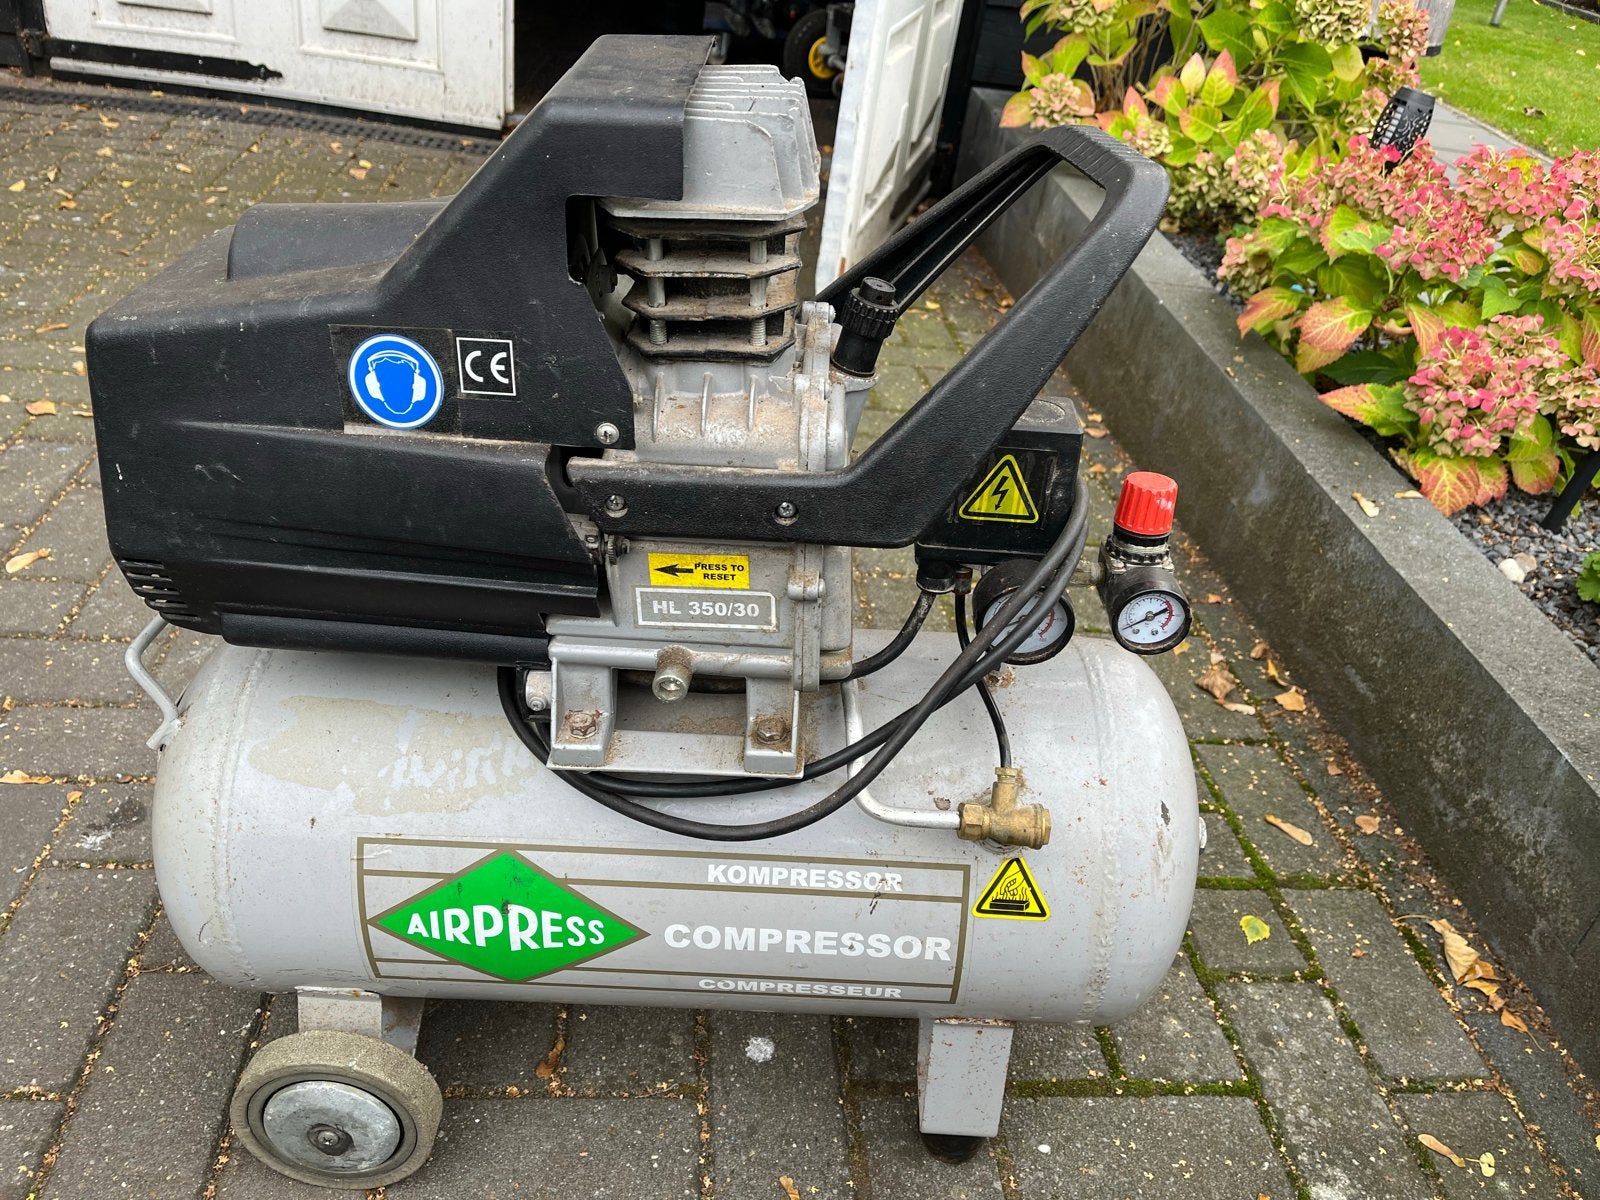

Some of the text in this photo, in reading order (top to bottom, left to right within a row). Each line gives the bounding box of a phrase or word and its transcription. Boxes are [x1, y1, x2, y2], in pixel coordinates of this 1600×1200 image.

[464, 350, 509, 384] CE
[694, 563, 744, 572] PRESS TO
[703, 573, 736, 581] RESET
[652, 600, 760, 617] HL 350/30
[707, 864, 903, 892] KOMPRESSOR
[407, 904, 605, 951] AIRPRESS
[664, 923, 952, 962] COMPRESSOR
[698, 978, 902, 998] COMPRESSEUR
